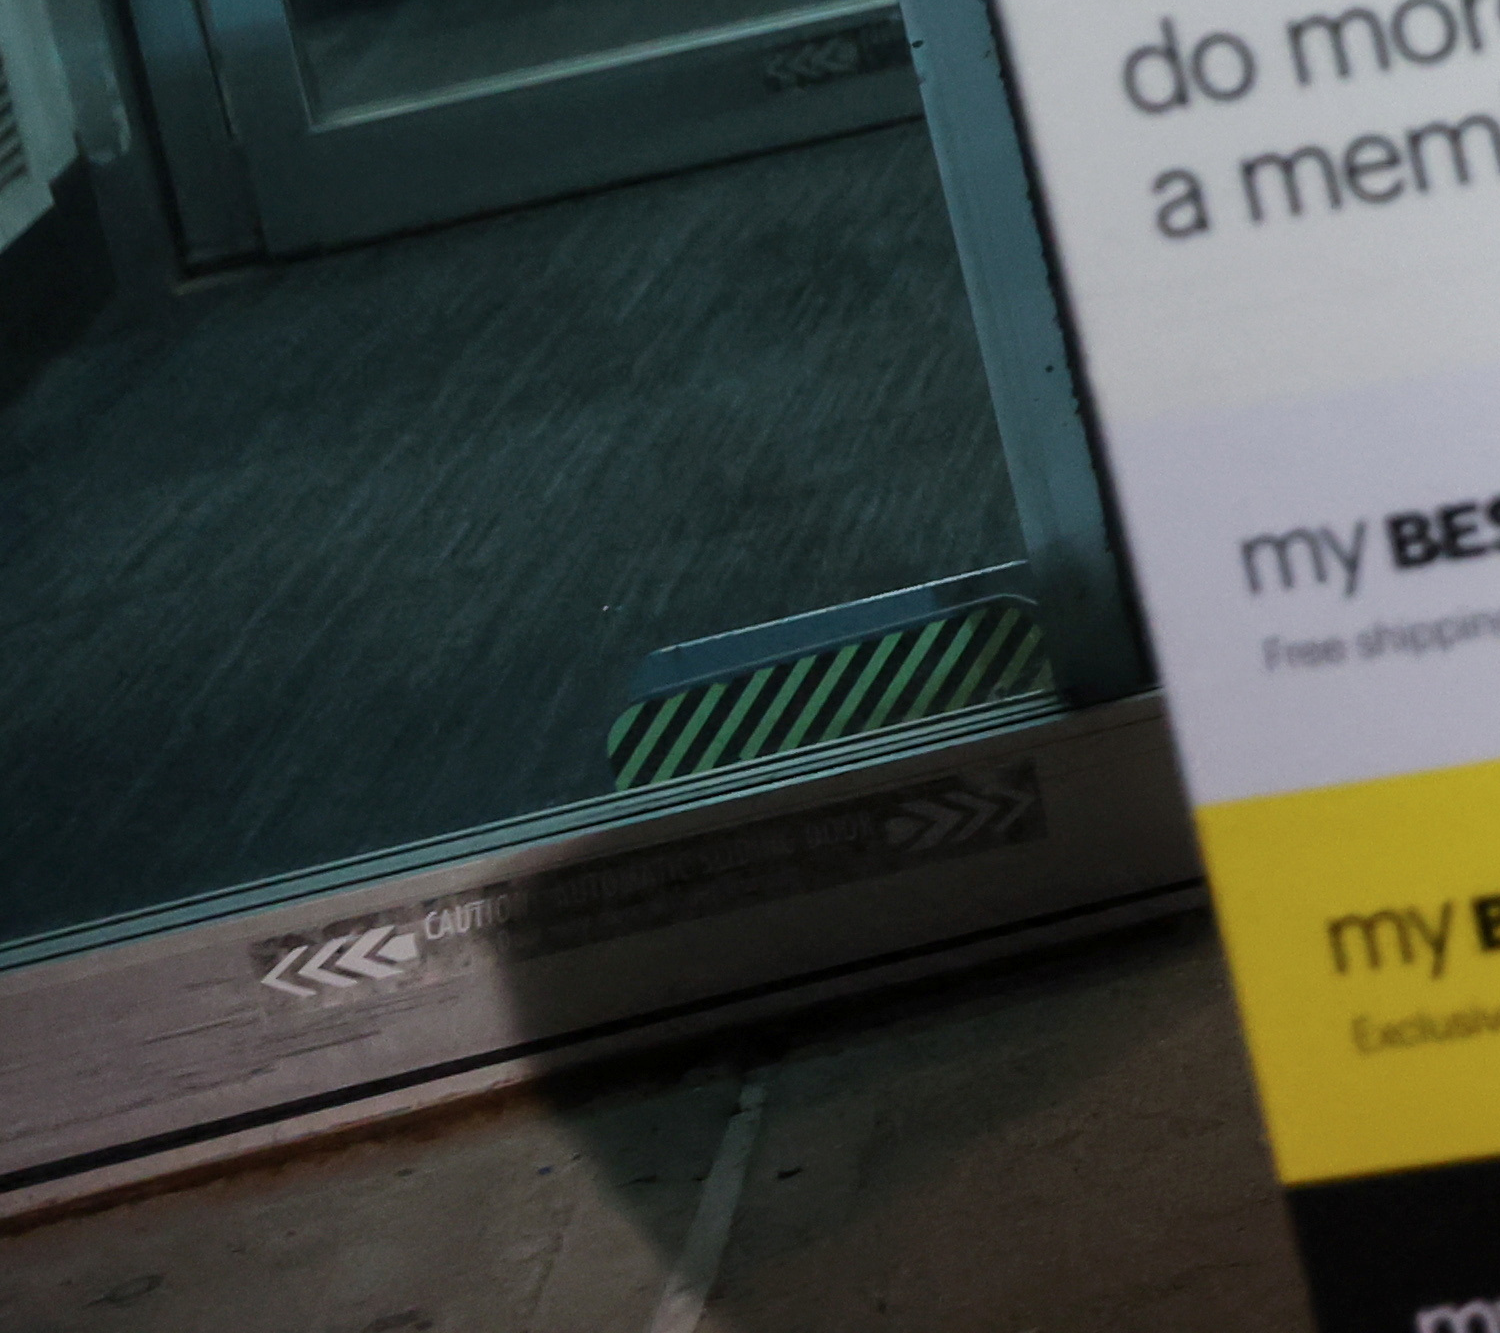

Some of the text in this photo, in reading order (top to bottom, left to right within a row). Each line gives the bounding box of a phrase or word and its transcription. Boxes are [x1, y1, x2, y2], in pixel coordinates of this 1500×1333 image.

[1122, 13, 1255, 116] do
[1151, 165, 1211, 240] a
[1239, 518, 1375, 605] my
[1262, 629, 1347, 673] Free
[1325, 900, 1458, 980] my
